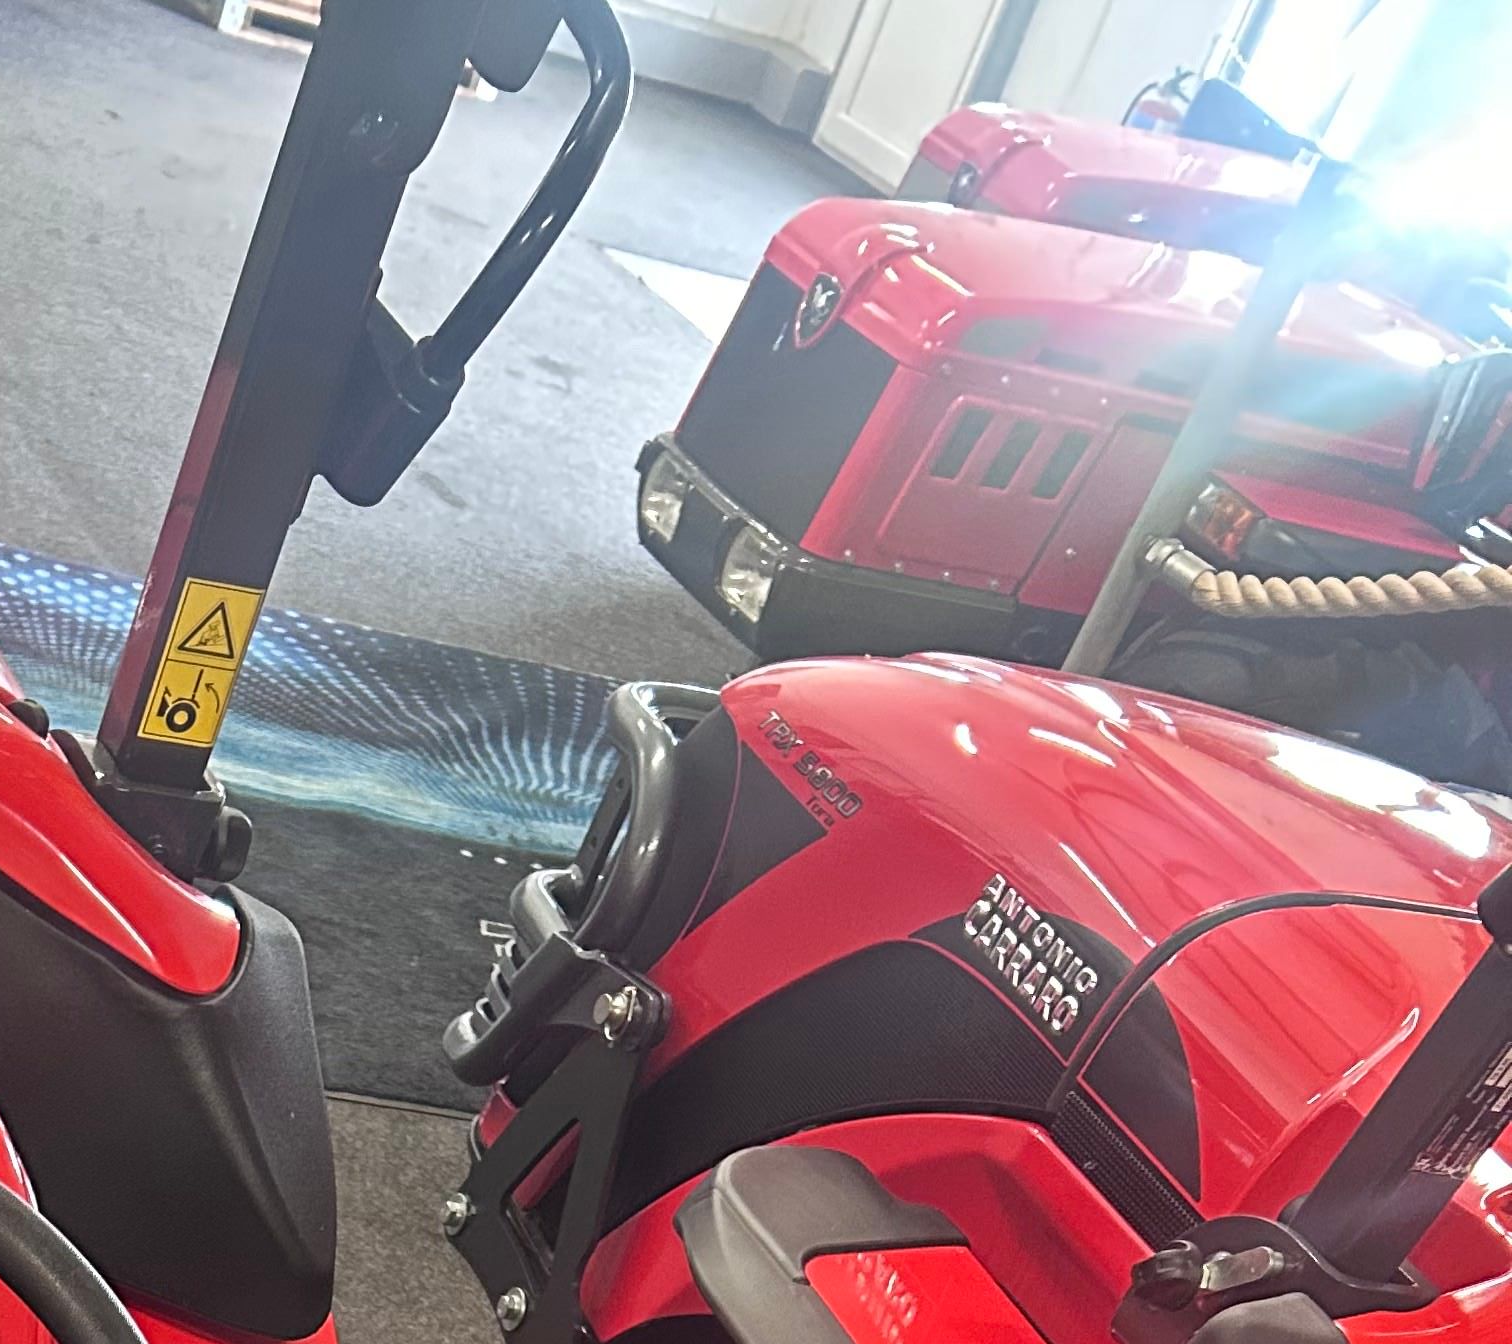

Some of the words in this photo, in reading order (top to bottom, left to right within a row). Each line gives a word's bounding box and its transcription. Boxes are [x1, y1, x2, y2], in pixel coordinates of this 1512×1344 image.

[758, 710, 804, 756] TRX
[794, 752, 863, 818] 5800
[963, 899, 1079, 1033] CARRARO
[984, 873, 1098, 995] ANTONIO
